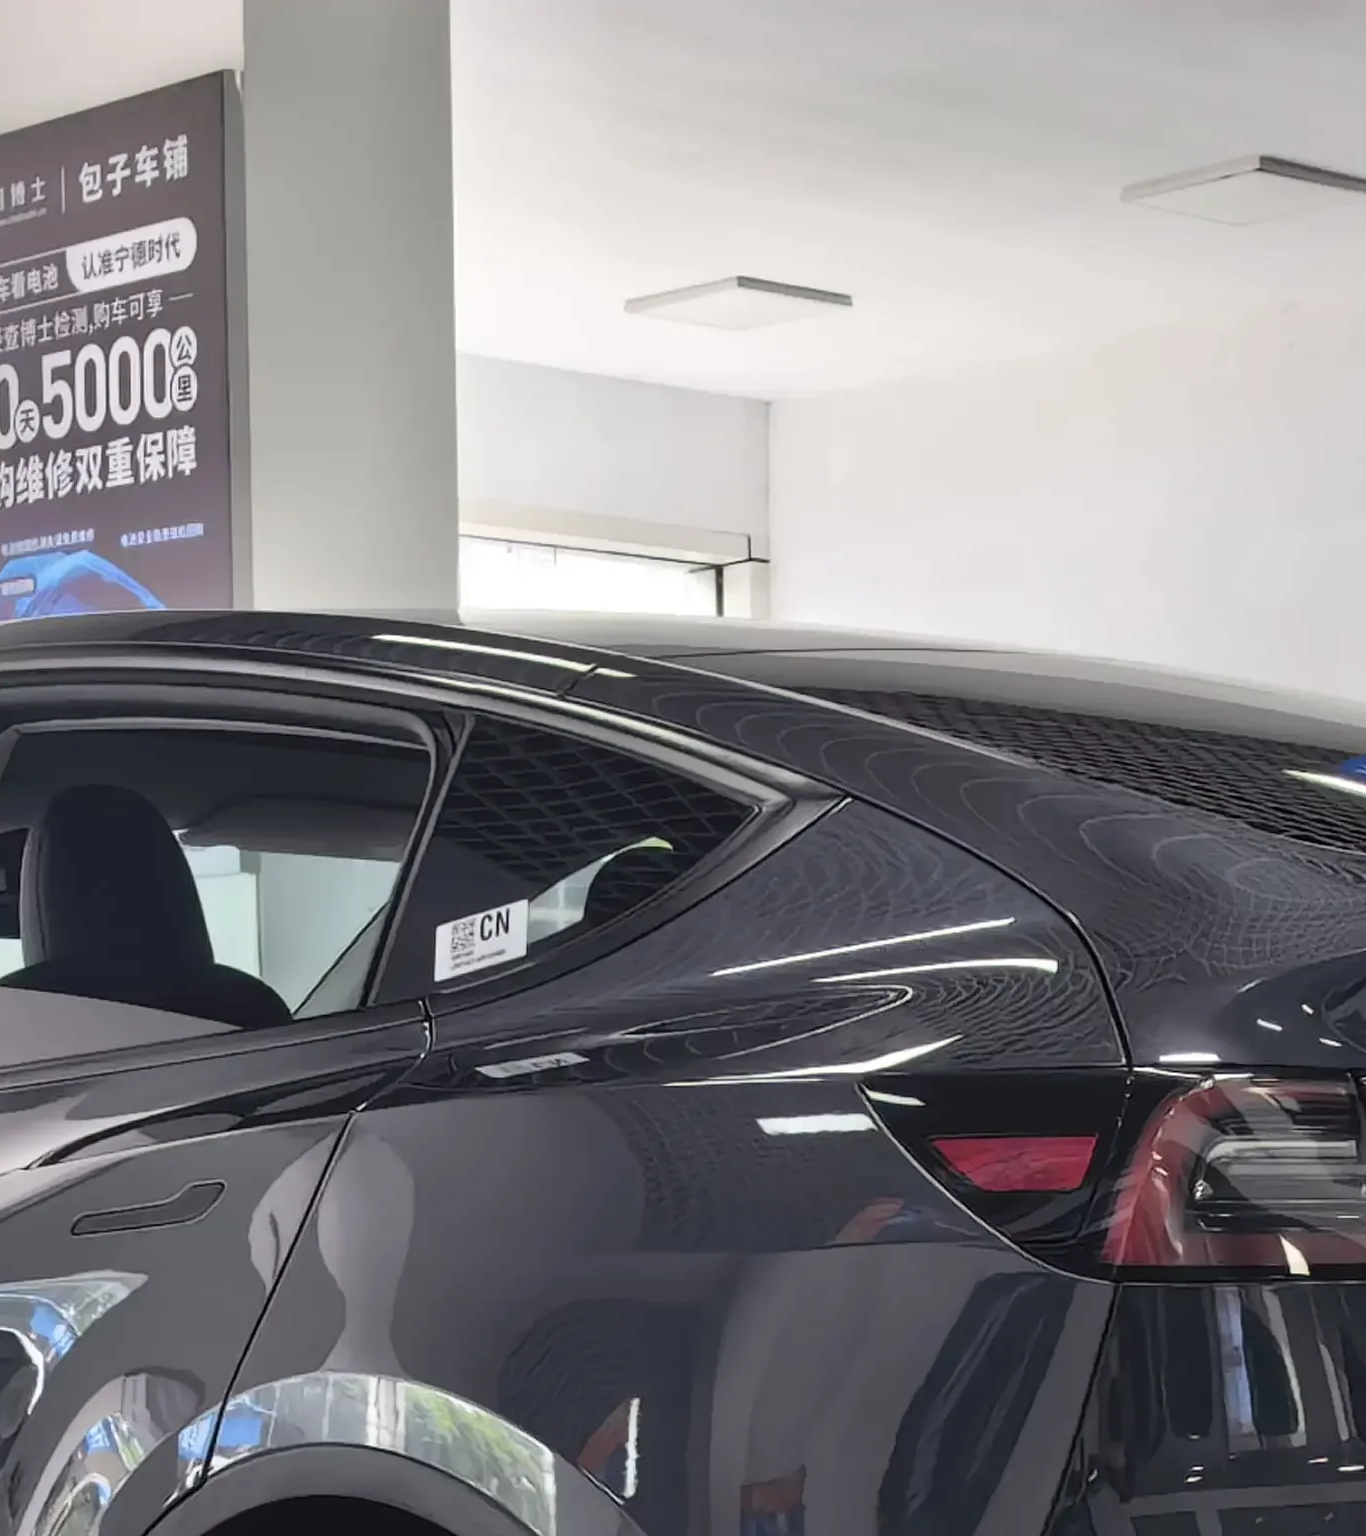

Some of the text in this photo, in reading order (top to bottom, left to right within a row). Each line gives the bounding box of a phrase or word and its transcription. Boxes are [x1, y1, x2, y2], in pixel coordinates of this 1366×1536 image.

[79, 134, 189, 203] 包子车铺
[81, 232, 181, 280] 认准宁德时代
[480, 908, 511, 942] CN
